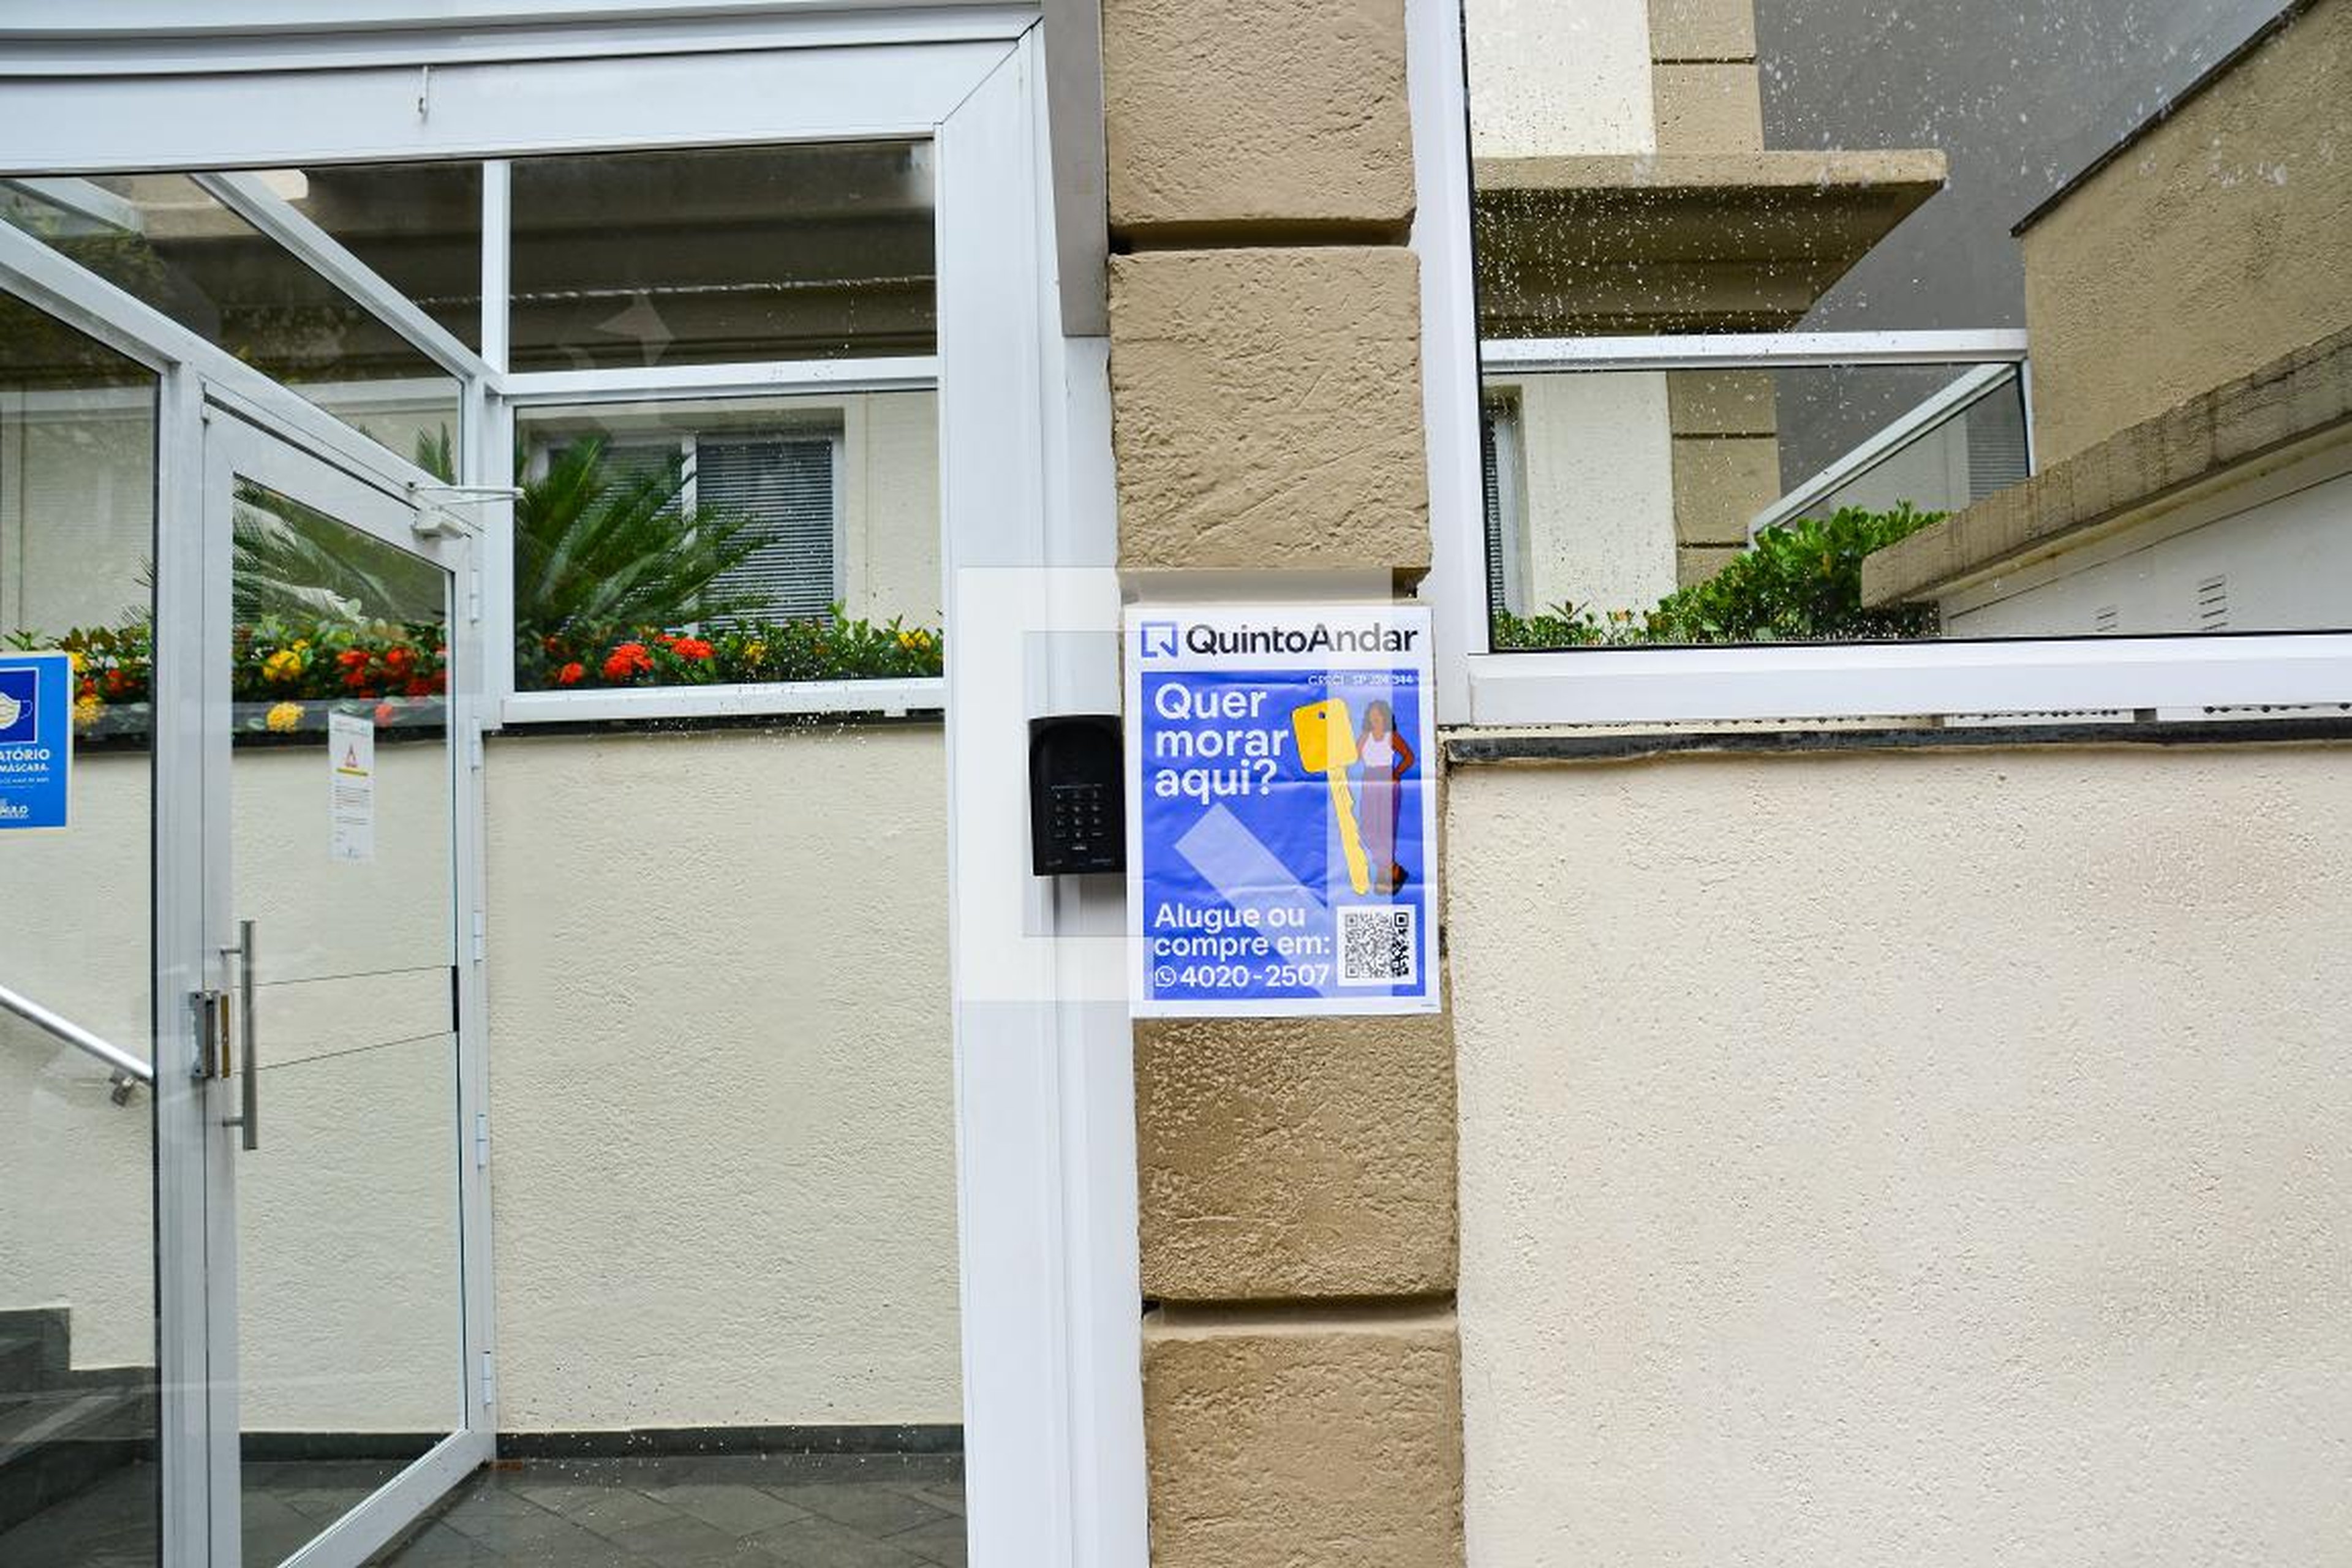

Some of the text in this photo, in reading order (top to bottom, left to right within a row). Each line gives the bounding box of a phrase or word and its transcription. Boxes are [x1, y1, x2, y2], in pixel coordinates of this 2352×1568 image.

[1186, 623, 1418, 656] QuintoAndar
[1155, 682, 1267, 720] Quer
[1155, 729, 1289, 758] morar
[1155, 759, 1277, 805] aqui?
[1154, 902, 1306, 934] Alugue ou
[1154, 934, 1331, 962] compre em:
